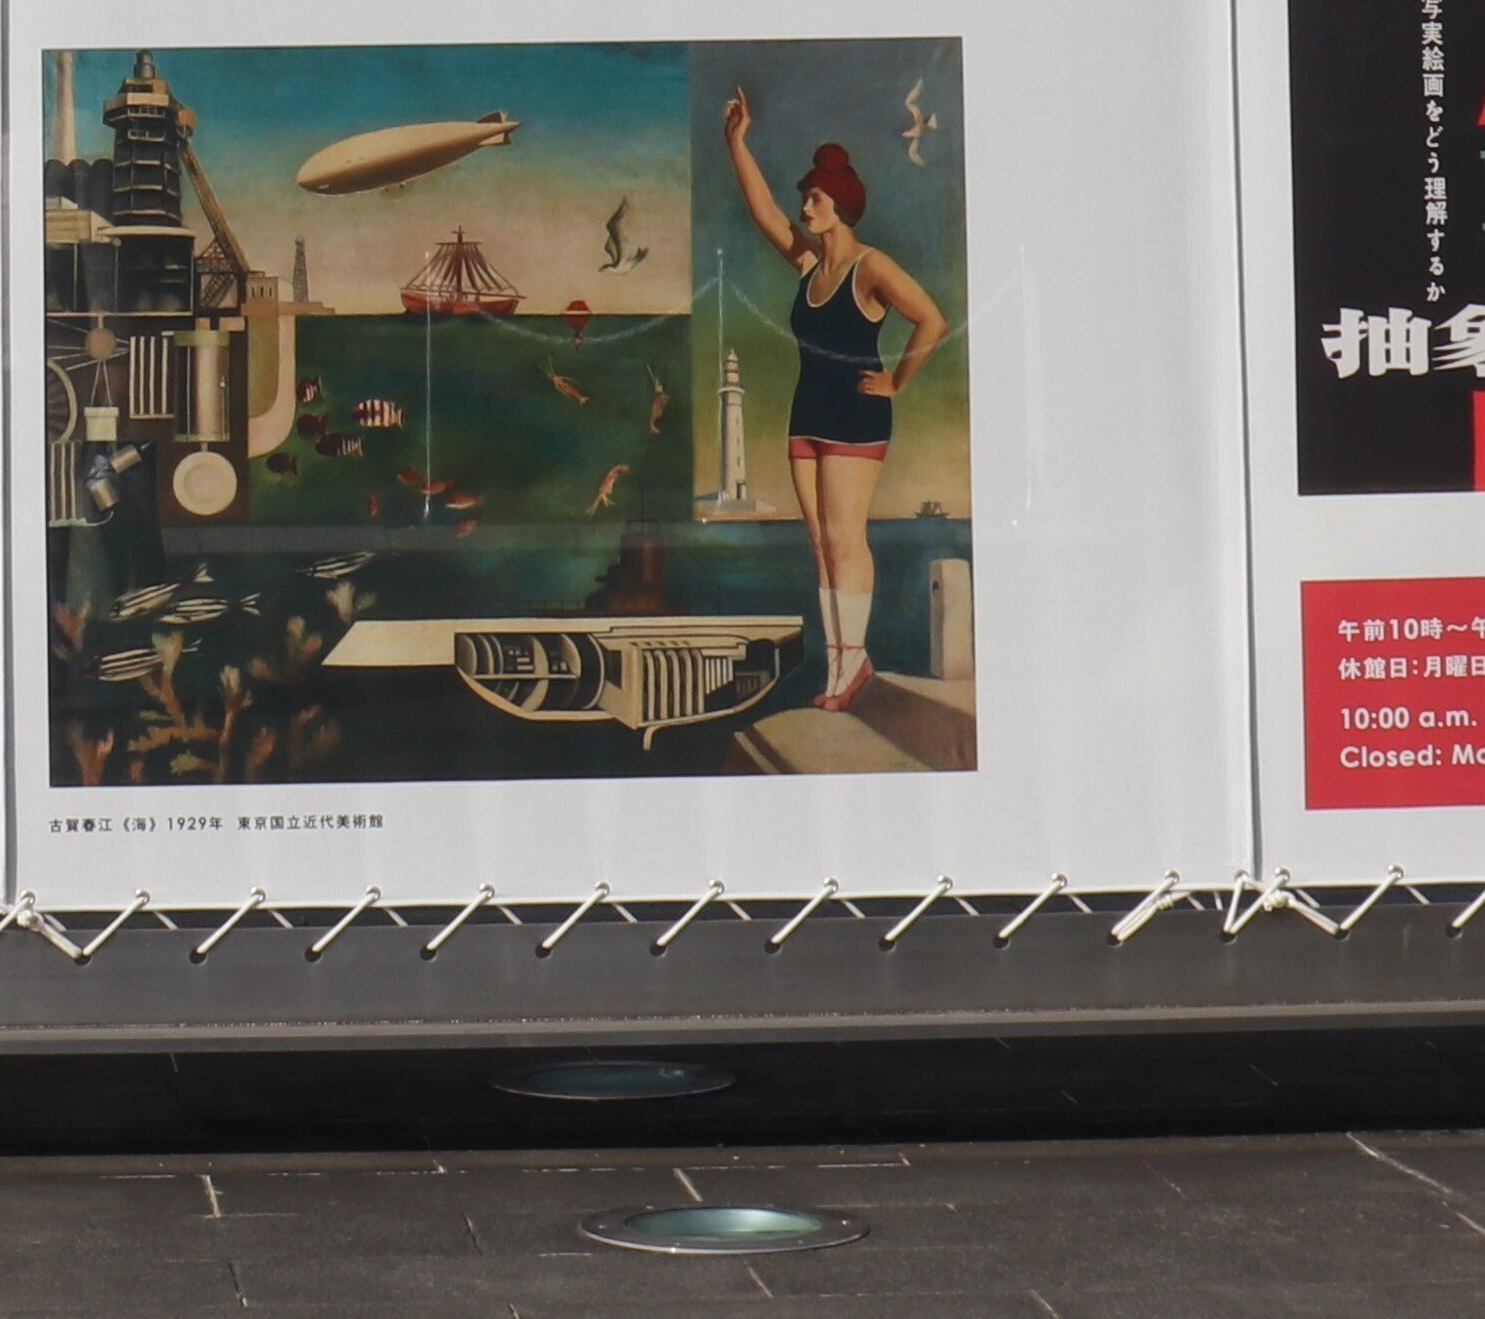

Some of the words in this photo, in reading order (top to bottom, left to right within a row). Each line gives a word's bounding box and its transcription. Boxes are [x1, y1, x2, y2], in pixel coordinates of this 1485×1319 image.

[1341, 706, 1410, 730] 10:00
[1418, 710, 1477, 728] a.m.
[1340, 744, 1442, 768] Closed:
[238, 814, 383, 830] 東京国立近代美術館
